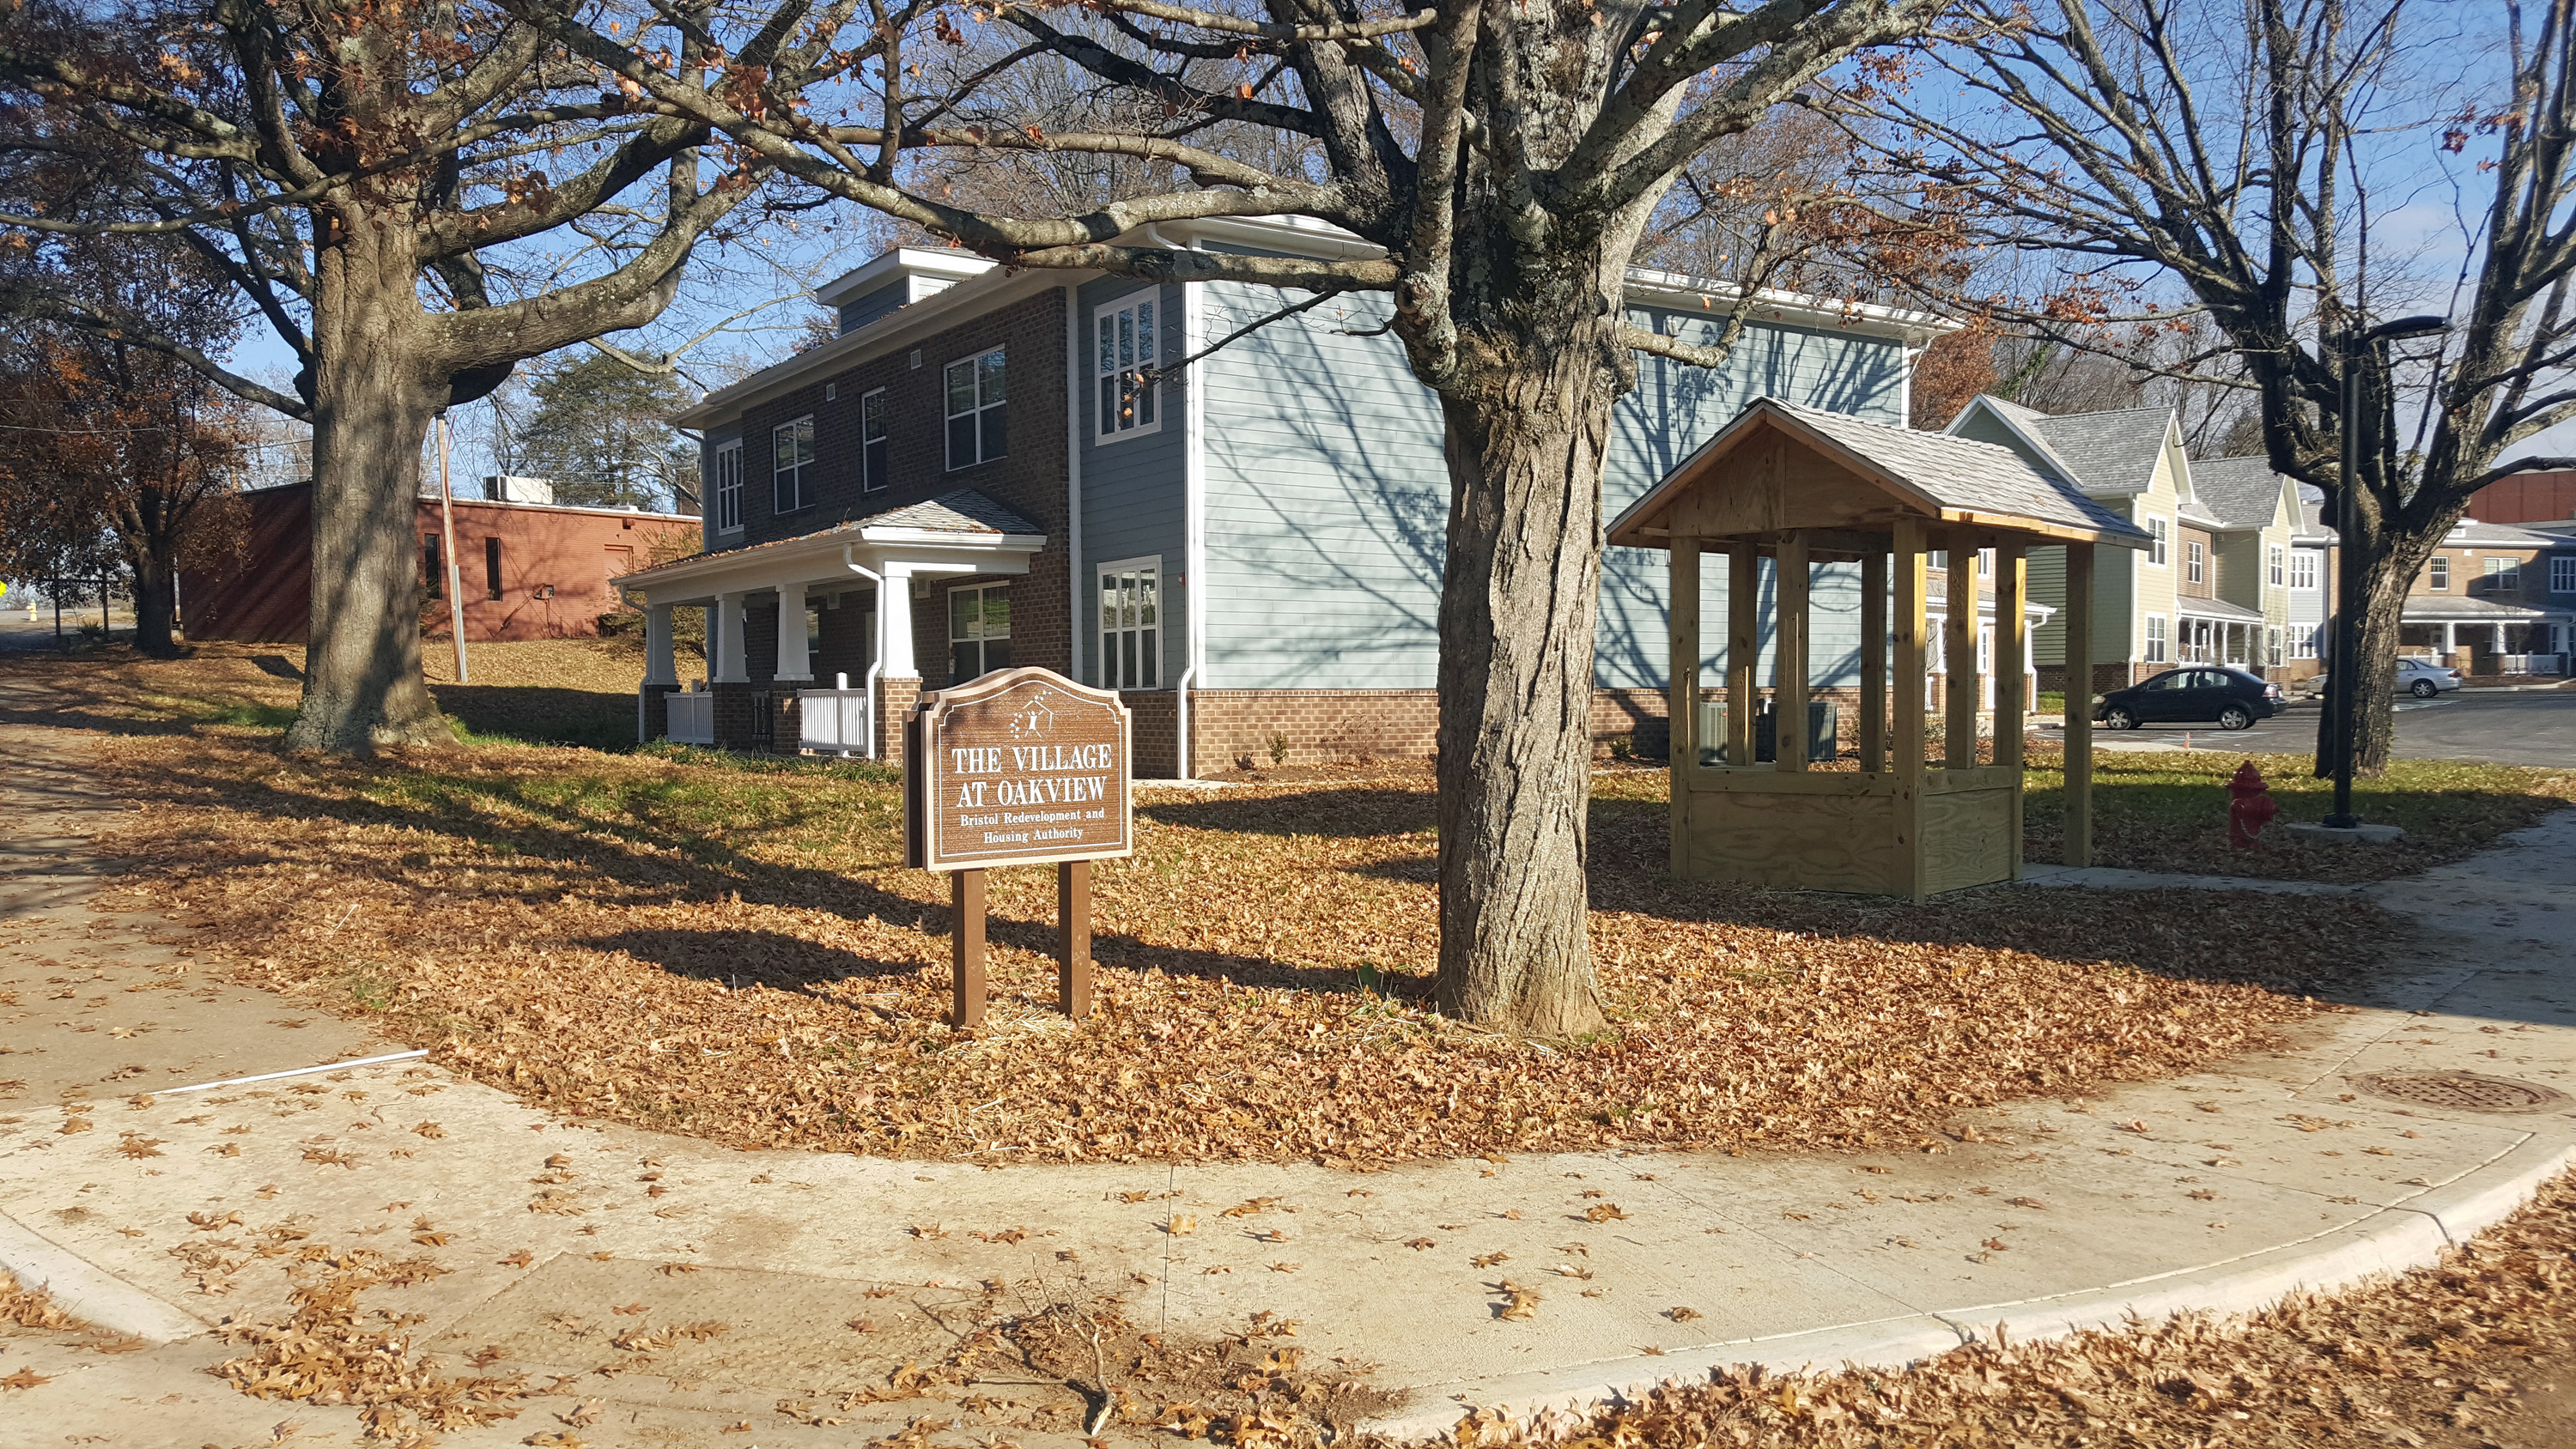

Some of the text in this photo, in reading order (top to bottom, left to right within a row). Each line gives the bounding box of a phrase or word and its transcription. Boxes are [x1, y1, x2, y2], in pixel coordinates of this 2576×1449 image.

[951, 743, 1112, 774] THE VILLAGE
[957, 776, 1108, 808] AT OAKVIEW
[960, 807, 1105, 827] Bristol Redevelopment and
[983, 827, 1084, 845] Housing Authority
